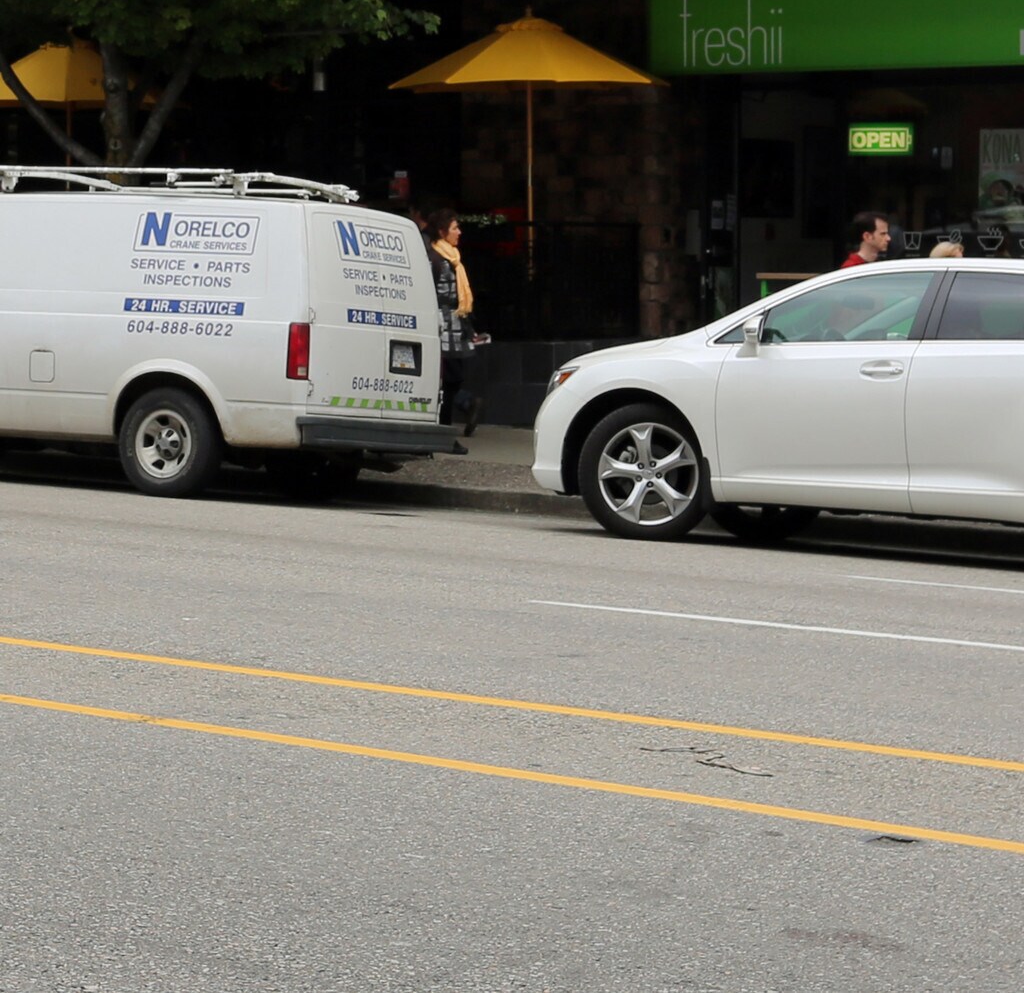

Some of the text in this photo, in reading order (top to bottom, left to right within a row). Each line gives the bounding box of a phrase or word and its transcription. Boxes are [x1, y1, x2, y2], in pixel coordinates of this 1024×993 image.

[852, 131, 906, 148] OPEN
[140, 211, 251, 247] NORELCO
[336, 219, 404, 256] NORELCO
[169, 240, 247, 251] CRANE SERVICES
[130, 258, 251, 274] SERVICE PARTS
[143, 274, 232, 288] INSPECTIONS
[343, 267, 414, 287] SERVICE PARTS
[355, 284, 407, 301] INSPECTIONS
[131, 299, 238, 315] 24 HR. SERVICE
[351, 310, 414, 328] 24 HR. SERVICE
[127, 320, 234, 337] 604-888-6022
[352, 376, 414, 394] 604-888-6022
